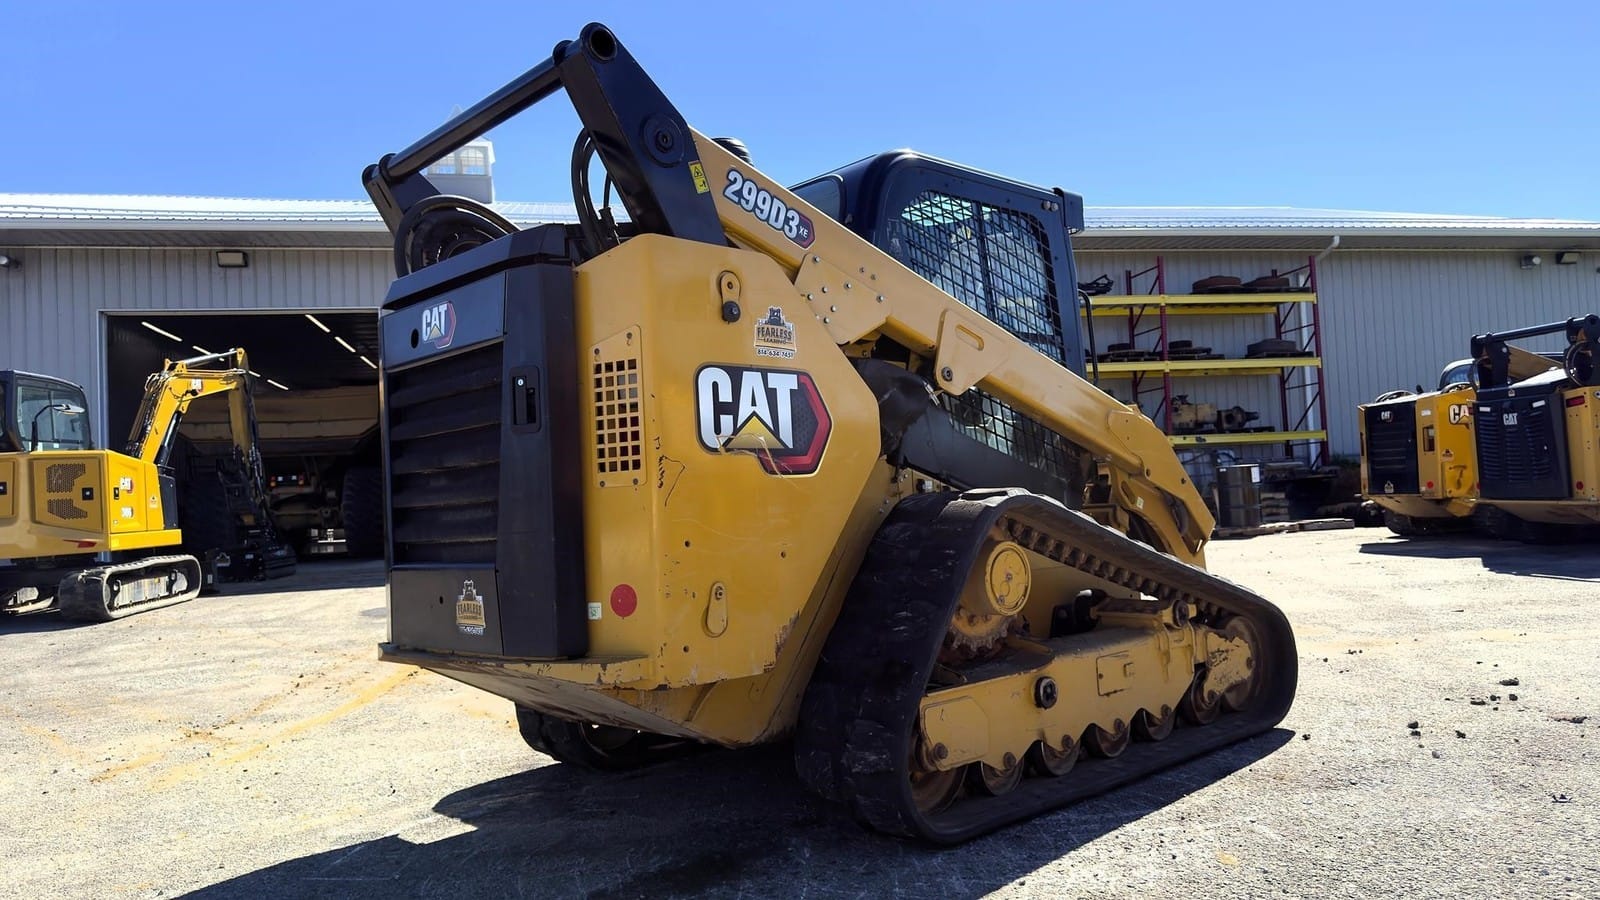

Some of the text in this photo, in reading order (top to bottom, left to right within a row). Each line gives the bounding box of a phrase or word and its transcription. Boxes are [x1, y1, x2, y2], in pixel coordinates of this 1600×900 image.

[724, 170, 809, 239] 299D3 XE
[422, 303, 448, 341] CAT
[757, 326, 792, 341] FEARLESS
[697, 366, 799, 449] CAT
[1449, 404, 1470, 424] CA
[1503, 412, 1518, 426] CAT
